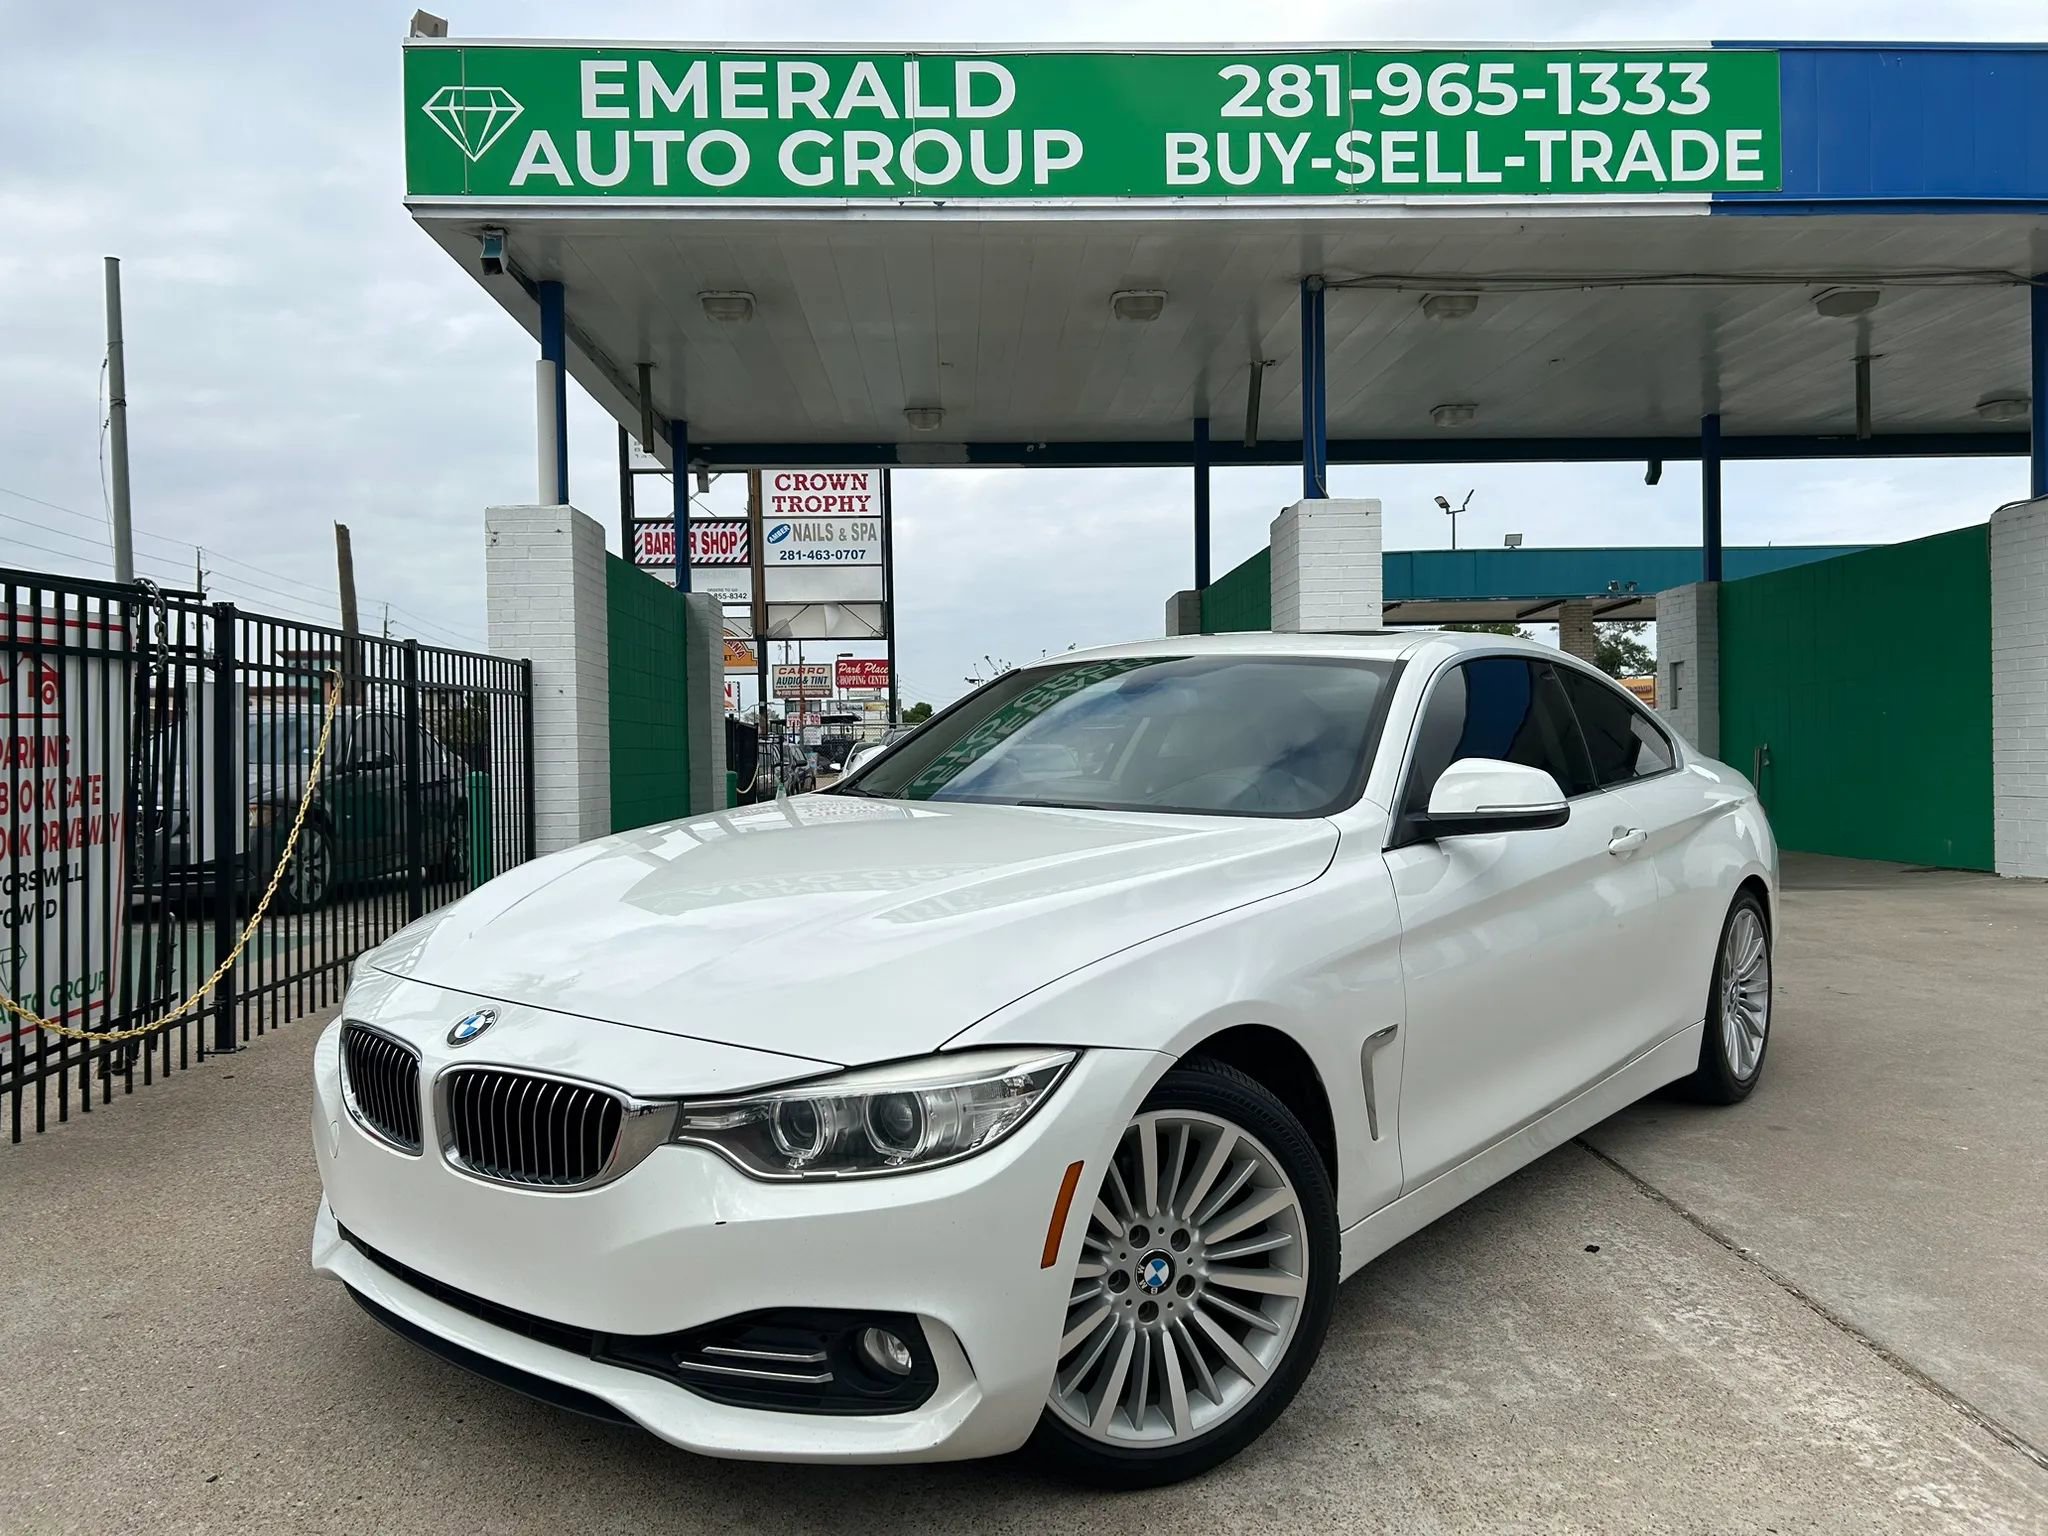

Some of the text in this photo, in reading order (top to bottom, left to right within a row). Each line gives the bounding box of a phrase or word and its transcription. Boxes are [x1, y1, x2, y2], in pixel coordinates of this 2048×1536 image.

[581, 61, 1015, 118] EMERALD
[1219, 63, 1710, 117] 281-965-1333
[510, 129, 1083, 186] AUTO GROUP
[1166, 130, 1763, 185] BUY-SELL-TRADE
[774, 473, 869, 491] CROWN
[772, 495, 871, 513] TROPHY
[644, 531, 738, 555] BARR SHOP
[792, 522, 878, 542] NAILS & SPA
[779, 549, 867, 561] 281-463-0707
[775, 675, 829, 685] AUDIO & TINT
[778, 667, 826, 675] CARRO
[838, 662, 862, 675] Park
[0, 736, 71, 770] ARIN
[0, 775, 103, 816] BOK GAE
[41, 812, 120, 853] DRVEWY
